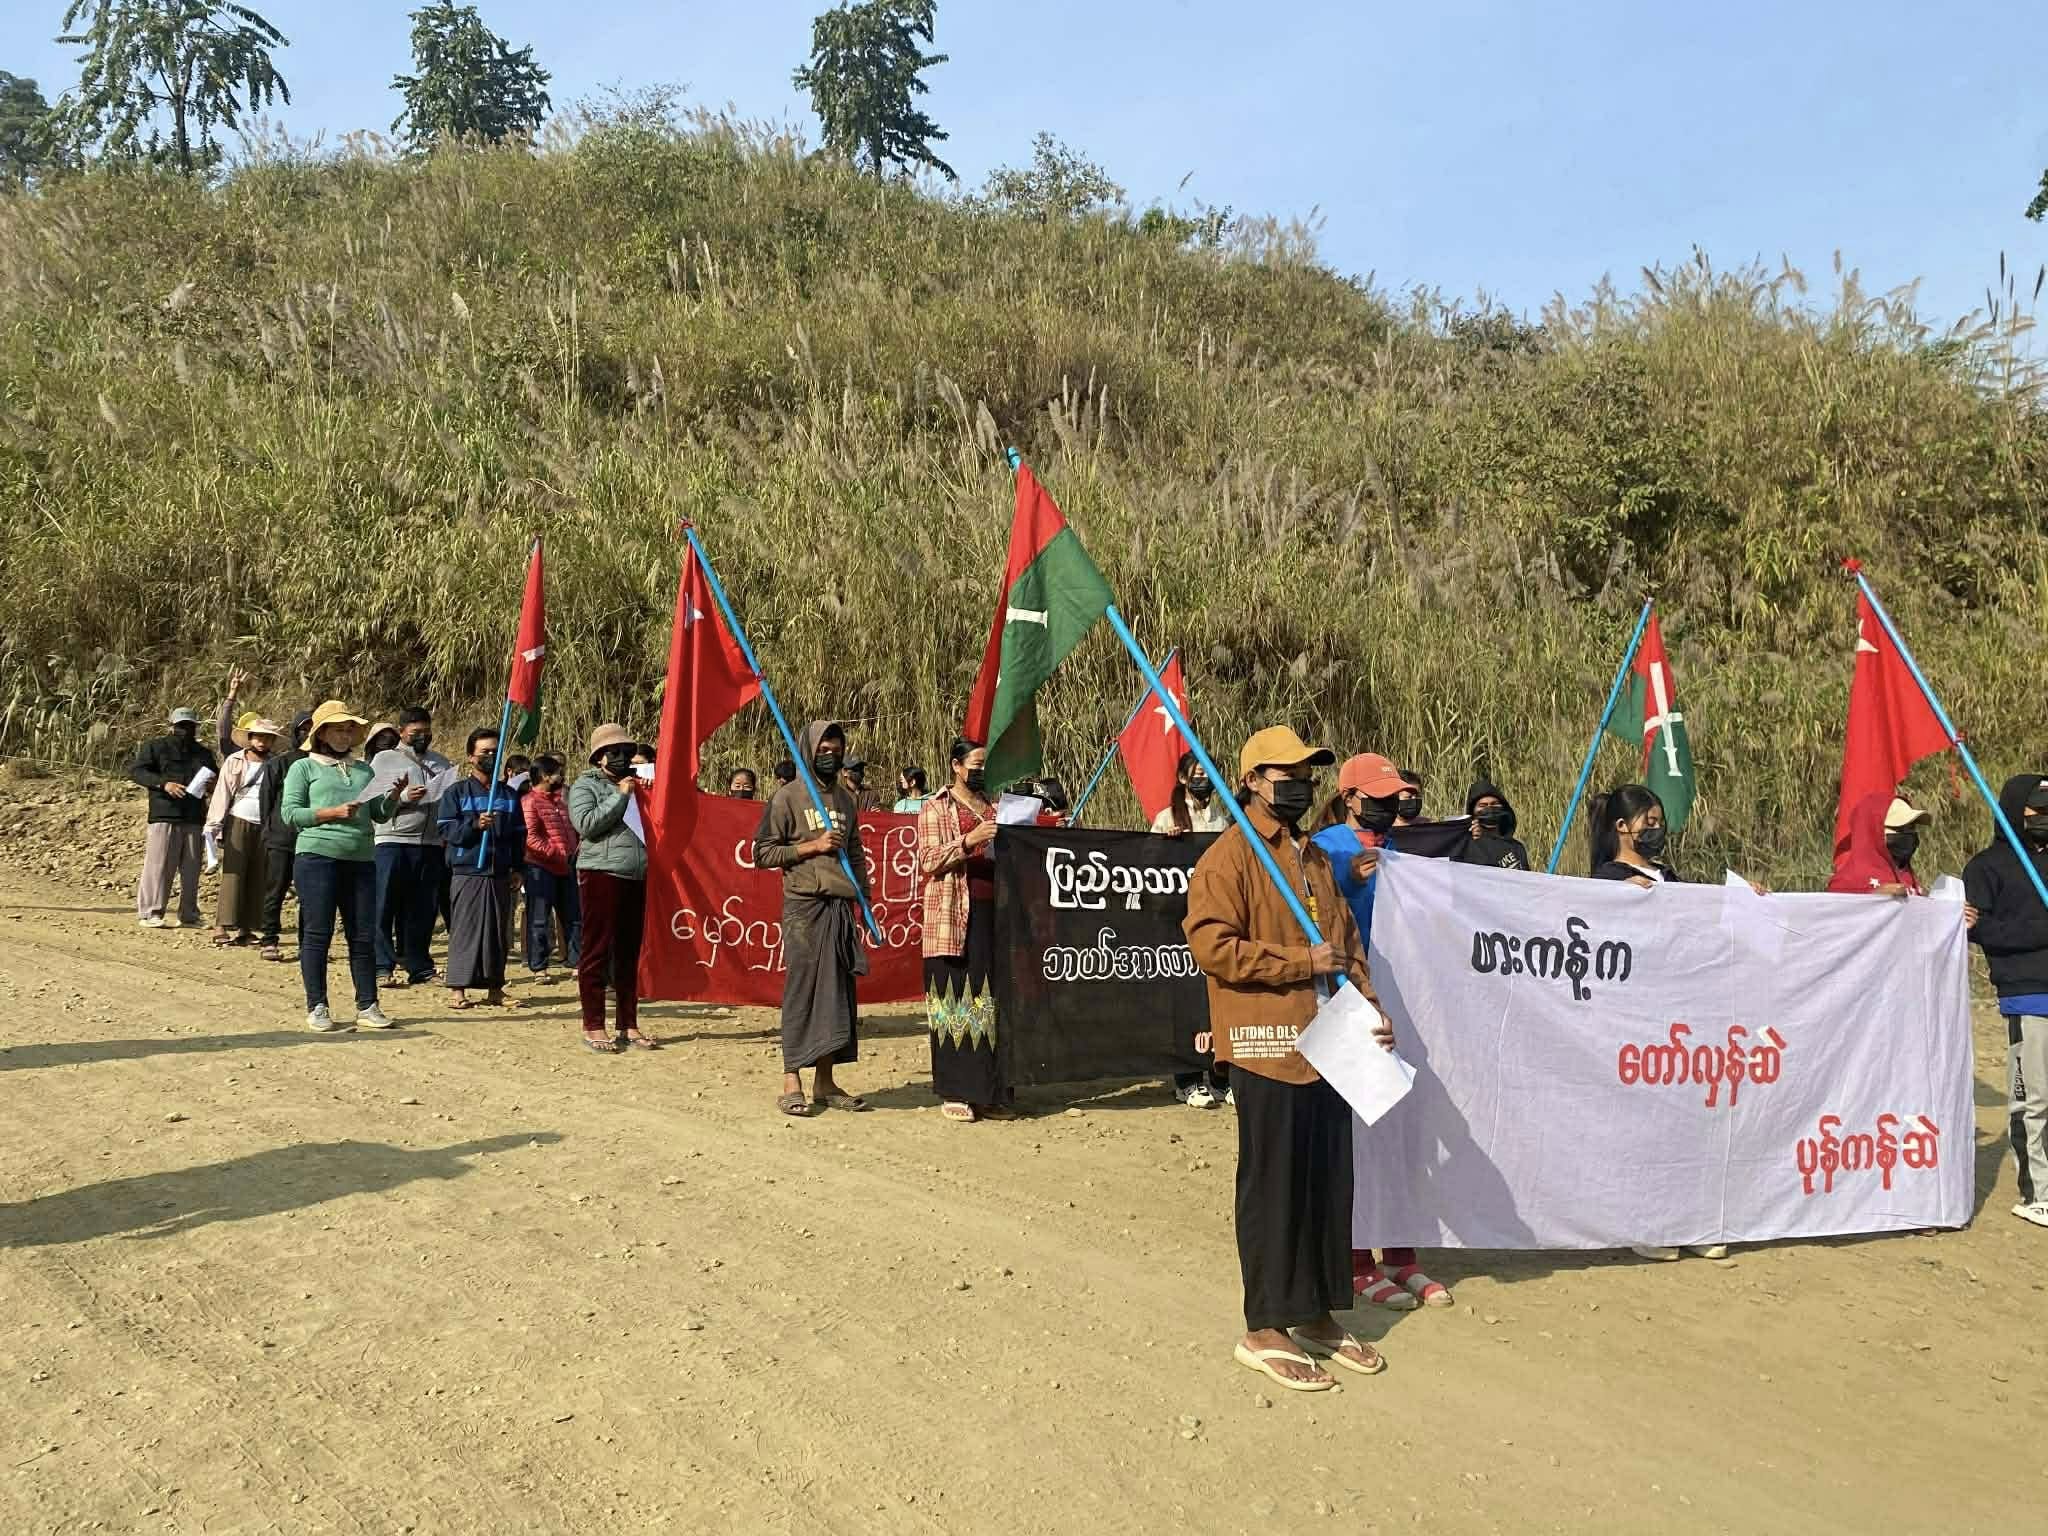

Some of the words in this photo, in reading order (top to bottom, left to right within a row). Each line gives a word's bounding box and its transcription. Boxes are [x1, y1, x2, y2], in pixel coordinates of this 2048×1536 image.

[1045, 847, 1196, 910] ပြည်သူသာ
[1618, 1022, 1788, 1108] တော်လှန်ဆဲ
